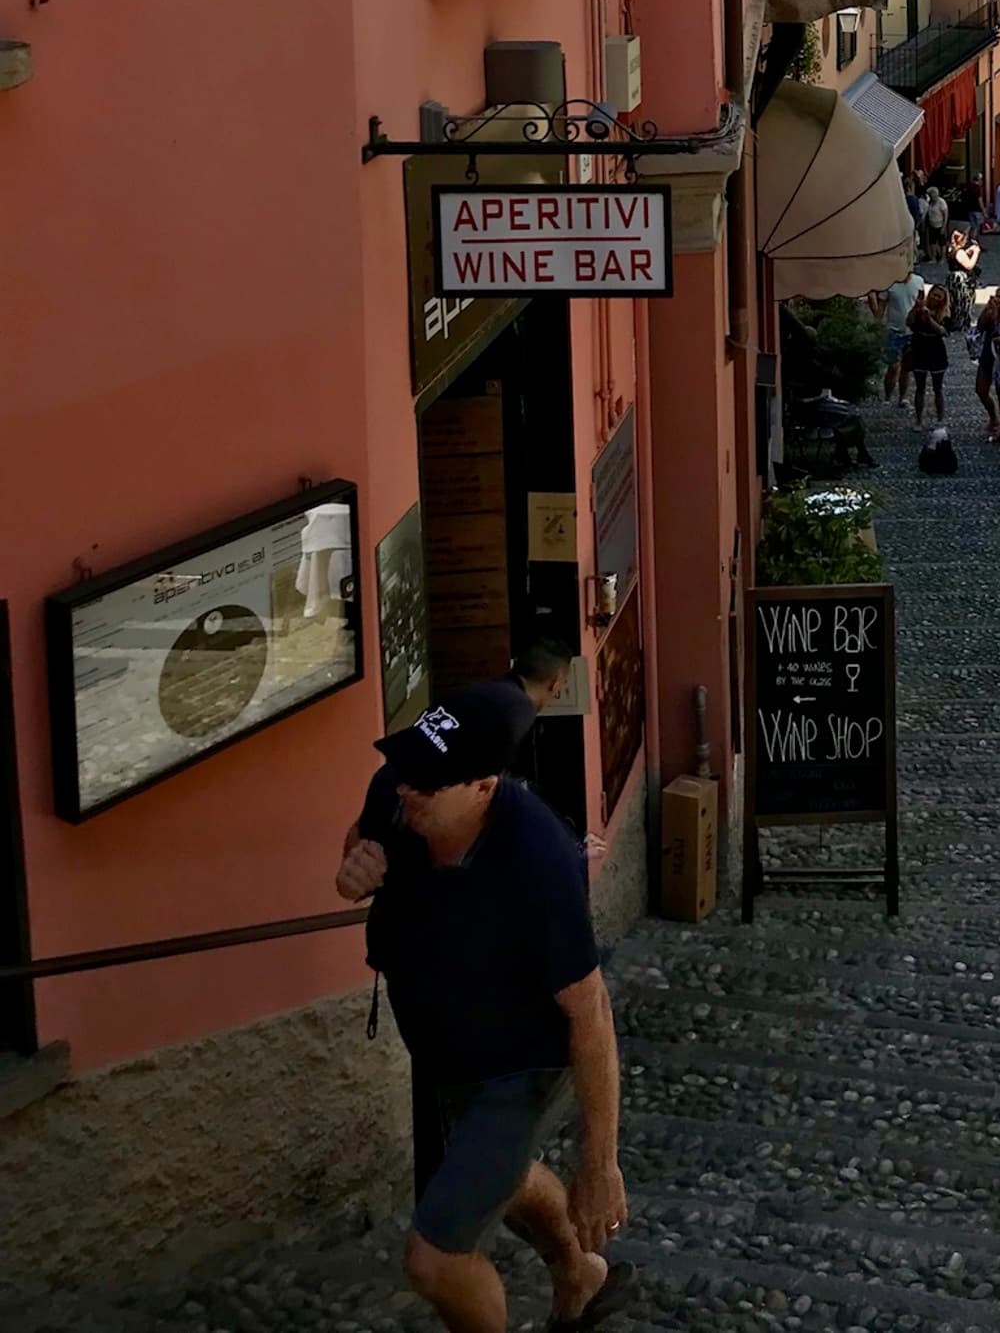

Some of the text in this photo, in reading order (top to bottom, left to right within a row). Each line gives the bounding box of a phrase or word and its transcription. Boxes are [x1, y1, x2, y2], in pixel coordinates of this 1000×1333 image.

[453, 197, 650, 231] APERITIVI
[453, 249, 653, 283] WINE BAR
[826, 713, 883, 761] SHOP
